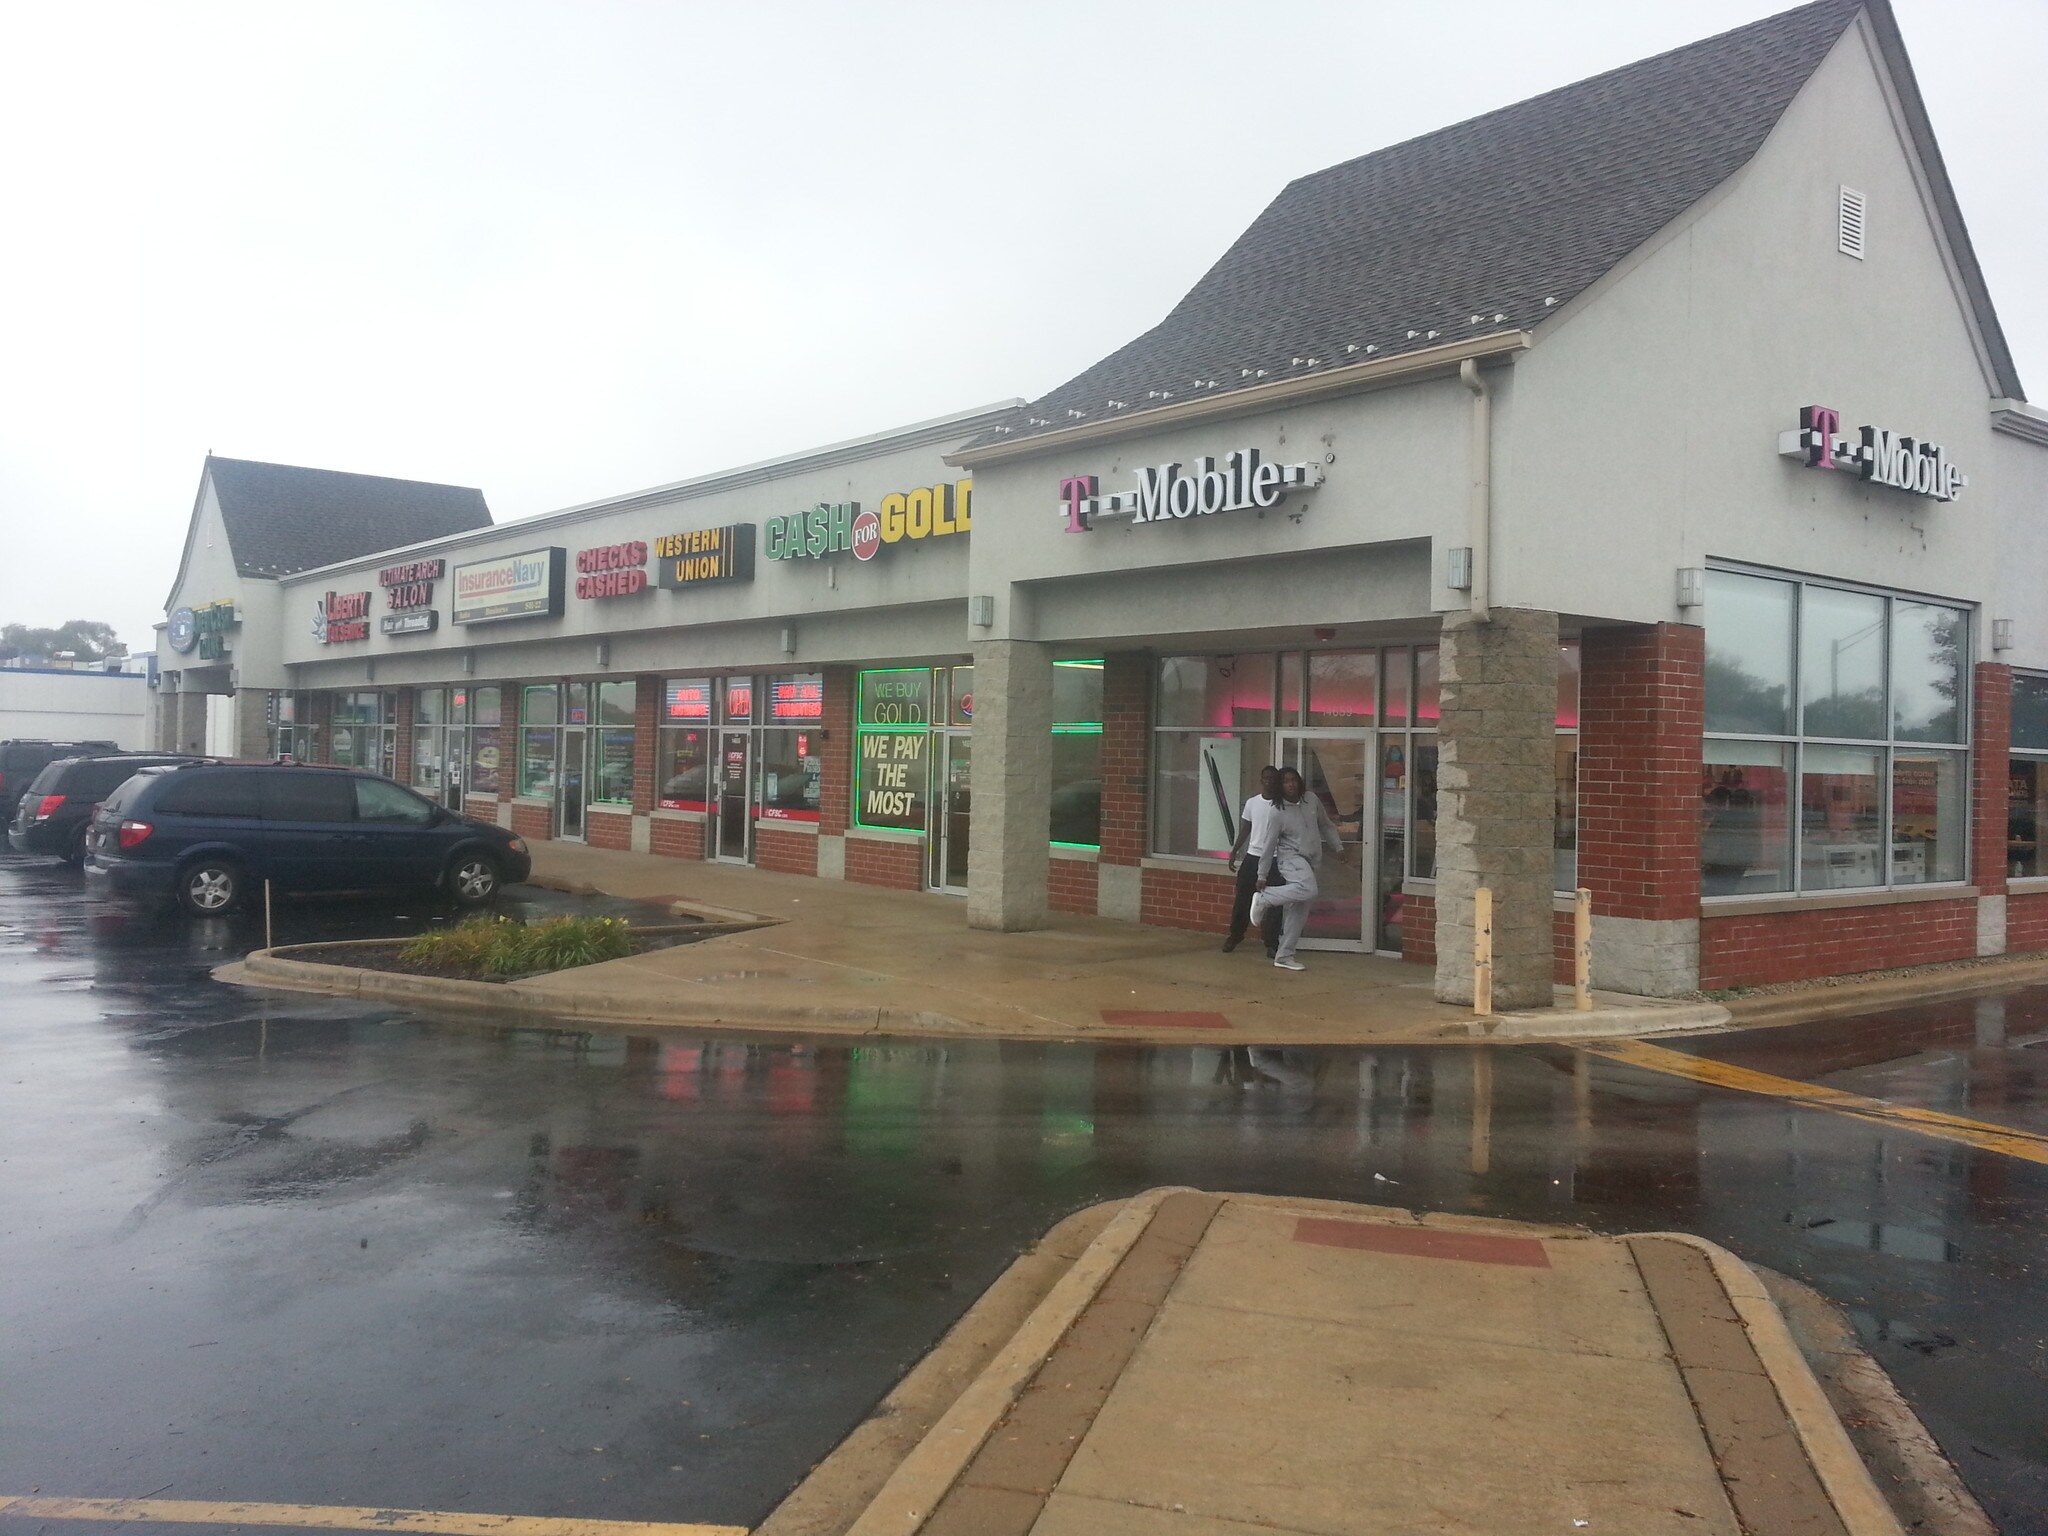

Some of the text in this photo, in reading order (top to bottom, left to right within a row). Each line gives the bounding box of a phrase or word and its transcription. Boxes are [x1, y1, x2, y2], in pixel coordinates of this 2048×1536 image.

[654, 527, 721, 559] WESTERN
[854, 525, 878, 547] FOR
[575, 540, 643, 573] CHECKS
[676, 555, 720, 583] UNION
[379, 559, 441, 587] ULTIMATE ARCH
[575, 570, 641, 600] CASHED
[326, 591, 367, 620] LIBERTY
[387, 582, 429, 609] SALON
[874, 681, 922, 699] WE BUY
[874, 702, 922, 725] GOLD
[863, 735, 924, 760] WE PAY
[877, 763, 909, 788] THE
[867, 790, 915, 816] MOST
